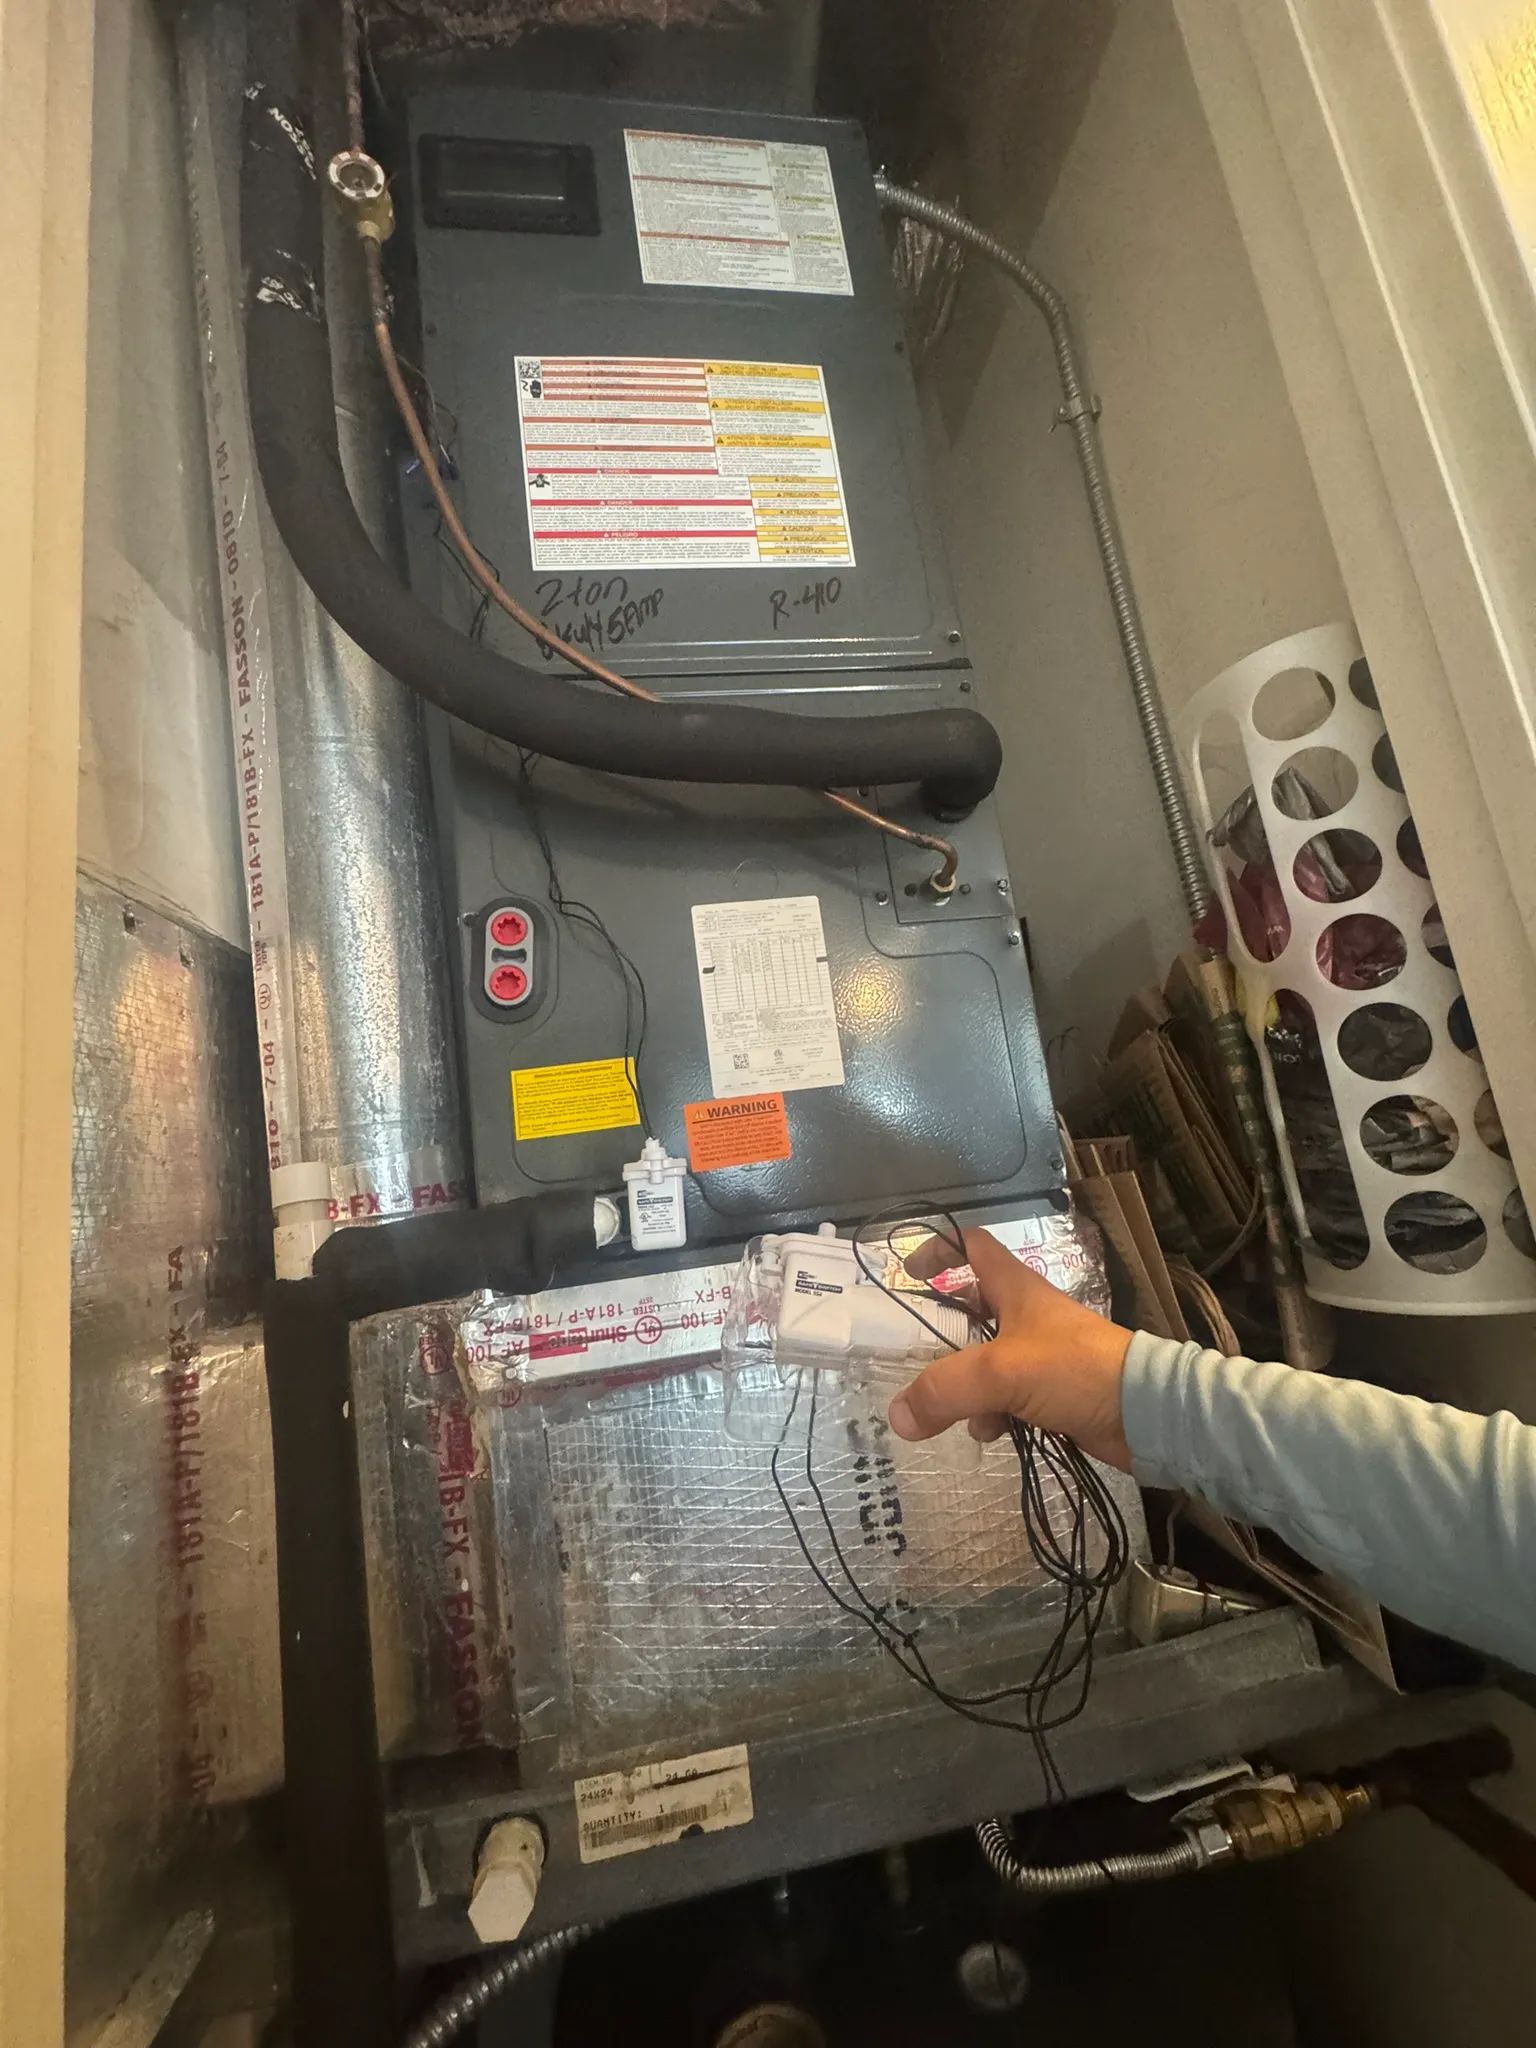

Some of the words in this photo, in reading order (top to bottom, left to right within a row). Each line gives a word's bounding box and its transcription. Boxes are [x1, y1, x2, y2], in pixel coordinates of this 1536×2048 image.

[222, 509, 239, 576] 0810
[231, 594, 251, 708] FASSON
[263, 1041, 277, 1089] 7-04
[706, 1098, 778, 1119] WARNING
[694, 1286, 732, 1304] B-FX
[568, 1302, 625, 1324] 181A-P
[680, 1311, 706, 1330] 100
[580, 1786, 614, 1803] 24X24
[583, 1809, 642, 1832] QUANTITY:
